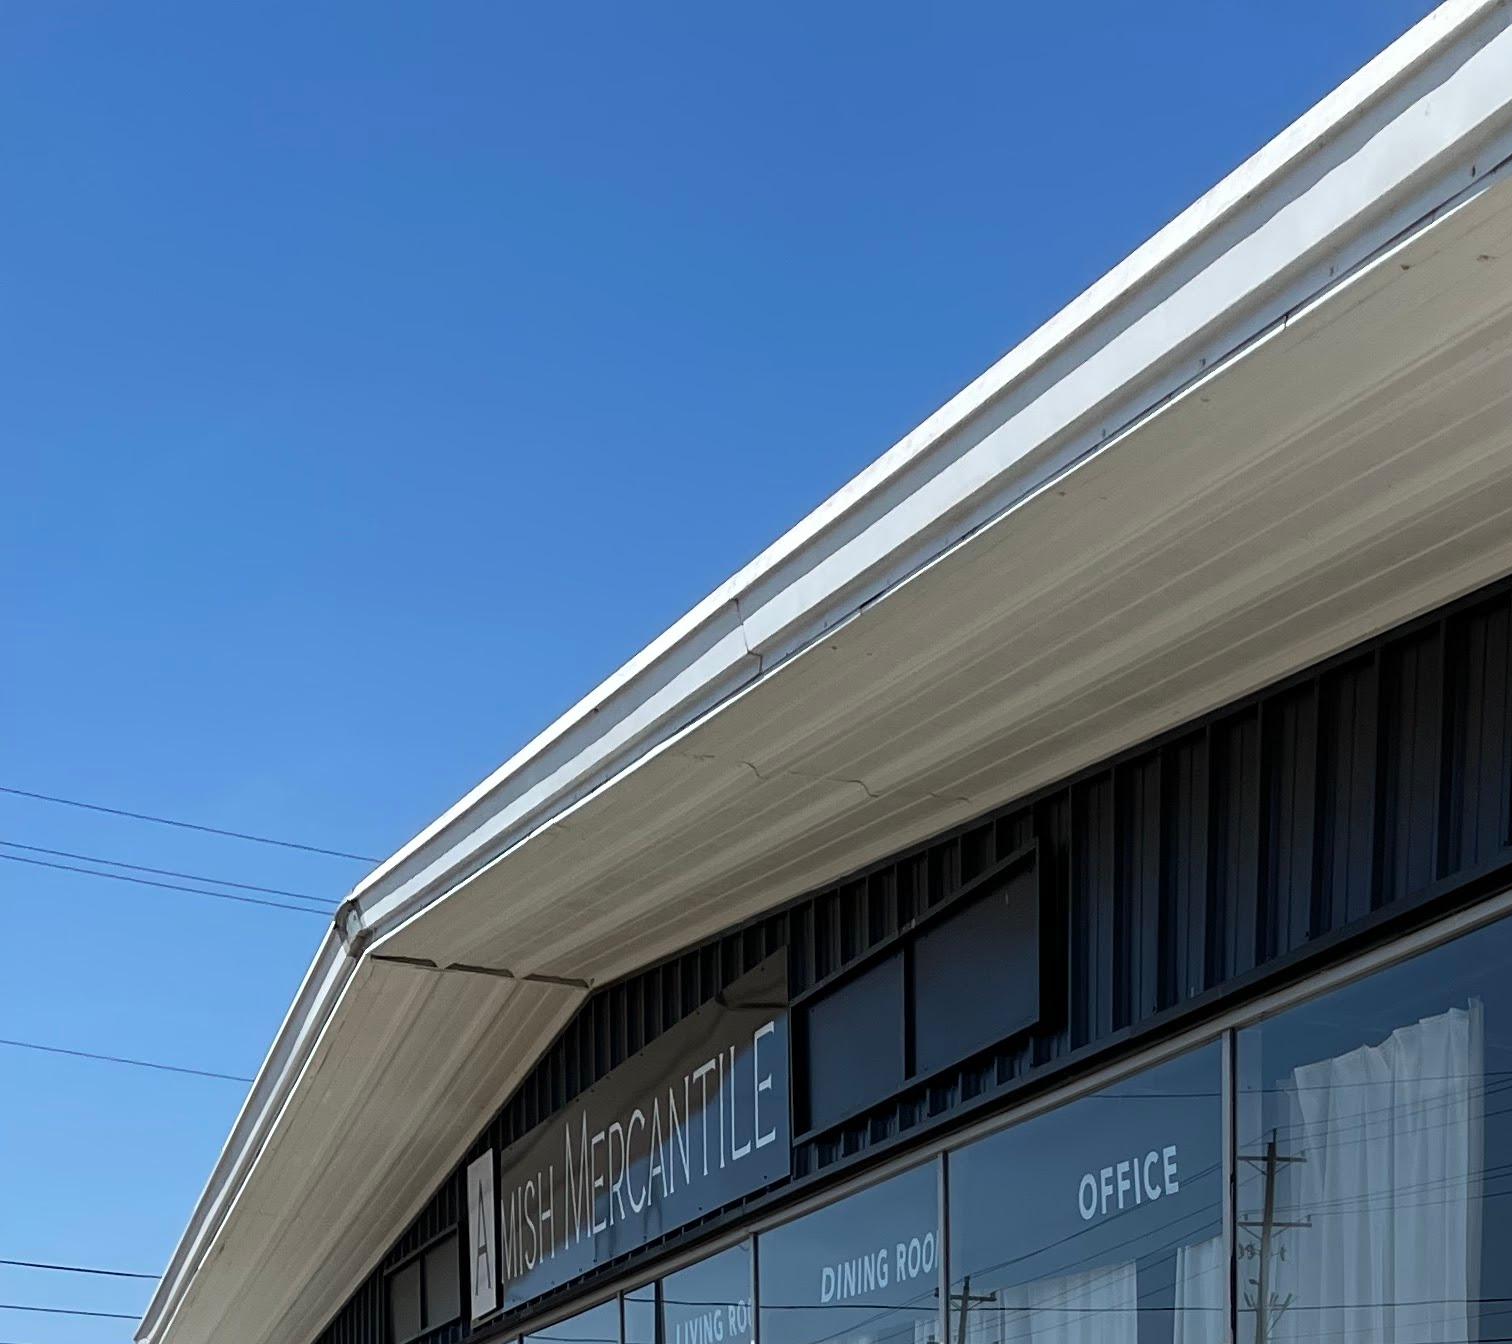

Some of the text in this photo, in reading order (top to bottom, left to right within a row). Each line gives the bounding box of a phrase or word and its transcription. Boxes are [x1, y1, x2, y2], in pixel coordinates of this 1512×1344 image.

[564, 1020, 777, 1251] MERCANTILE
[1078, 1144, 1180, 1220] OFFICE
[821, 1229, 939, 1304] DINING ROO
